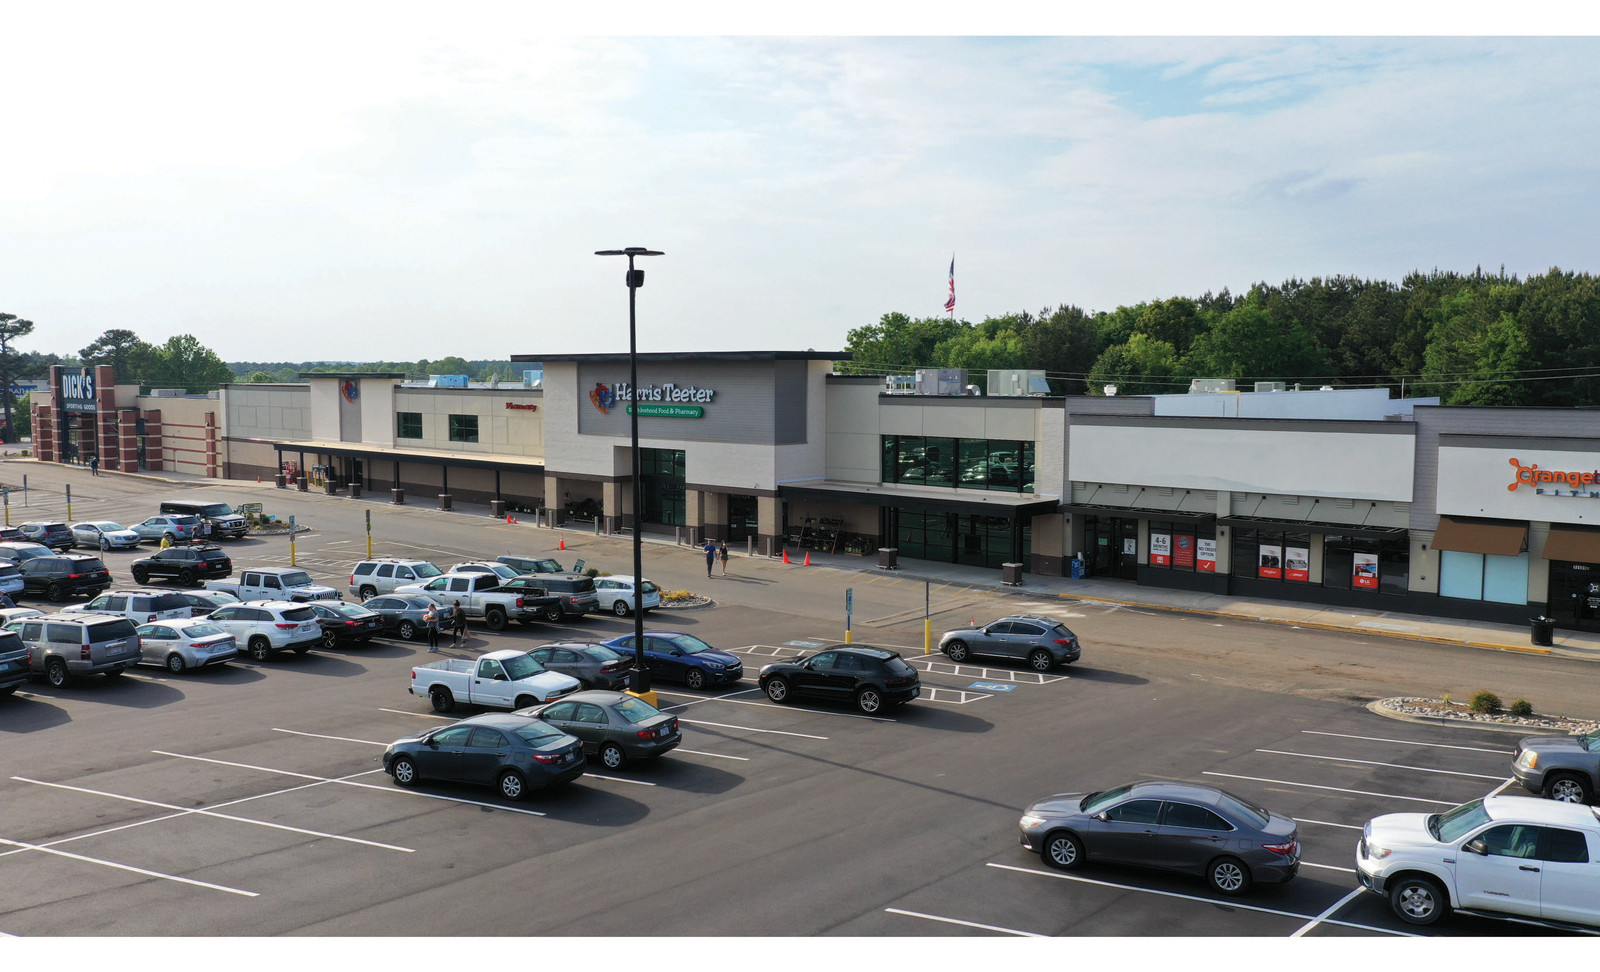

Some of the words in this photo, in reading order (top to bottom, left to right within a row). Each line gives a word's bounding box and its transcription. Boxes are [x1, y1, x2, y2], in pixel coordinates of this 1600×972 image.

[62, 375, 93, 399] DICK'S
[615, 383, 662, 401] Harris
[663, 383, 714, 402] Teeter
[1155, 536, 1166, 545] 4-6
